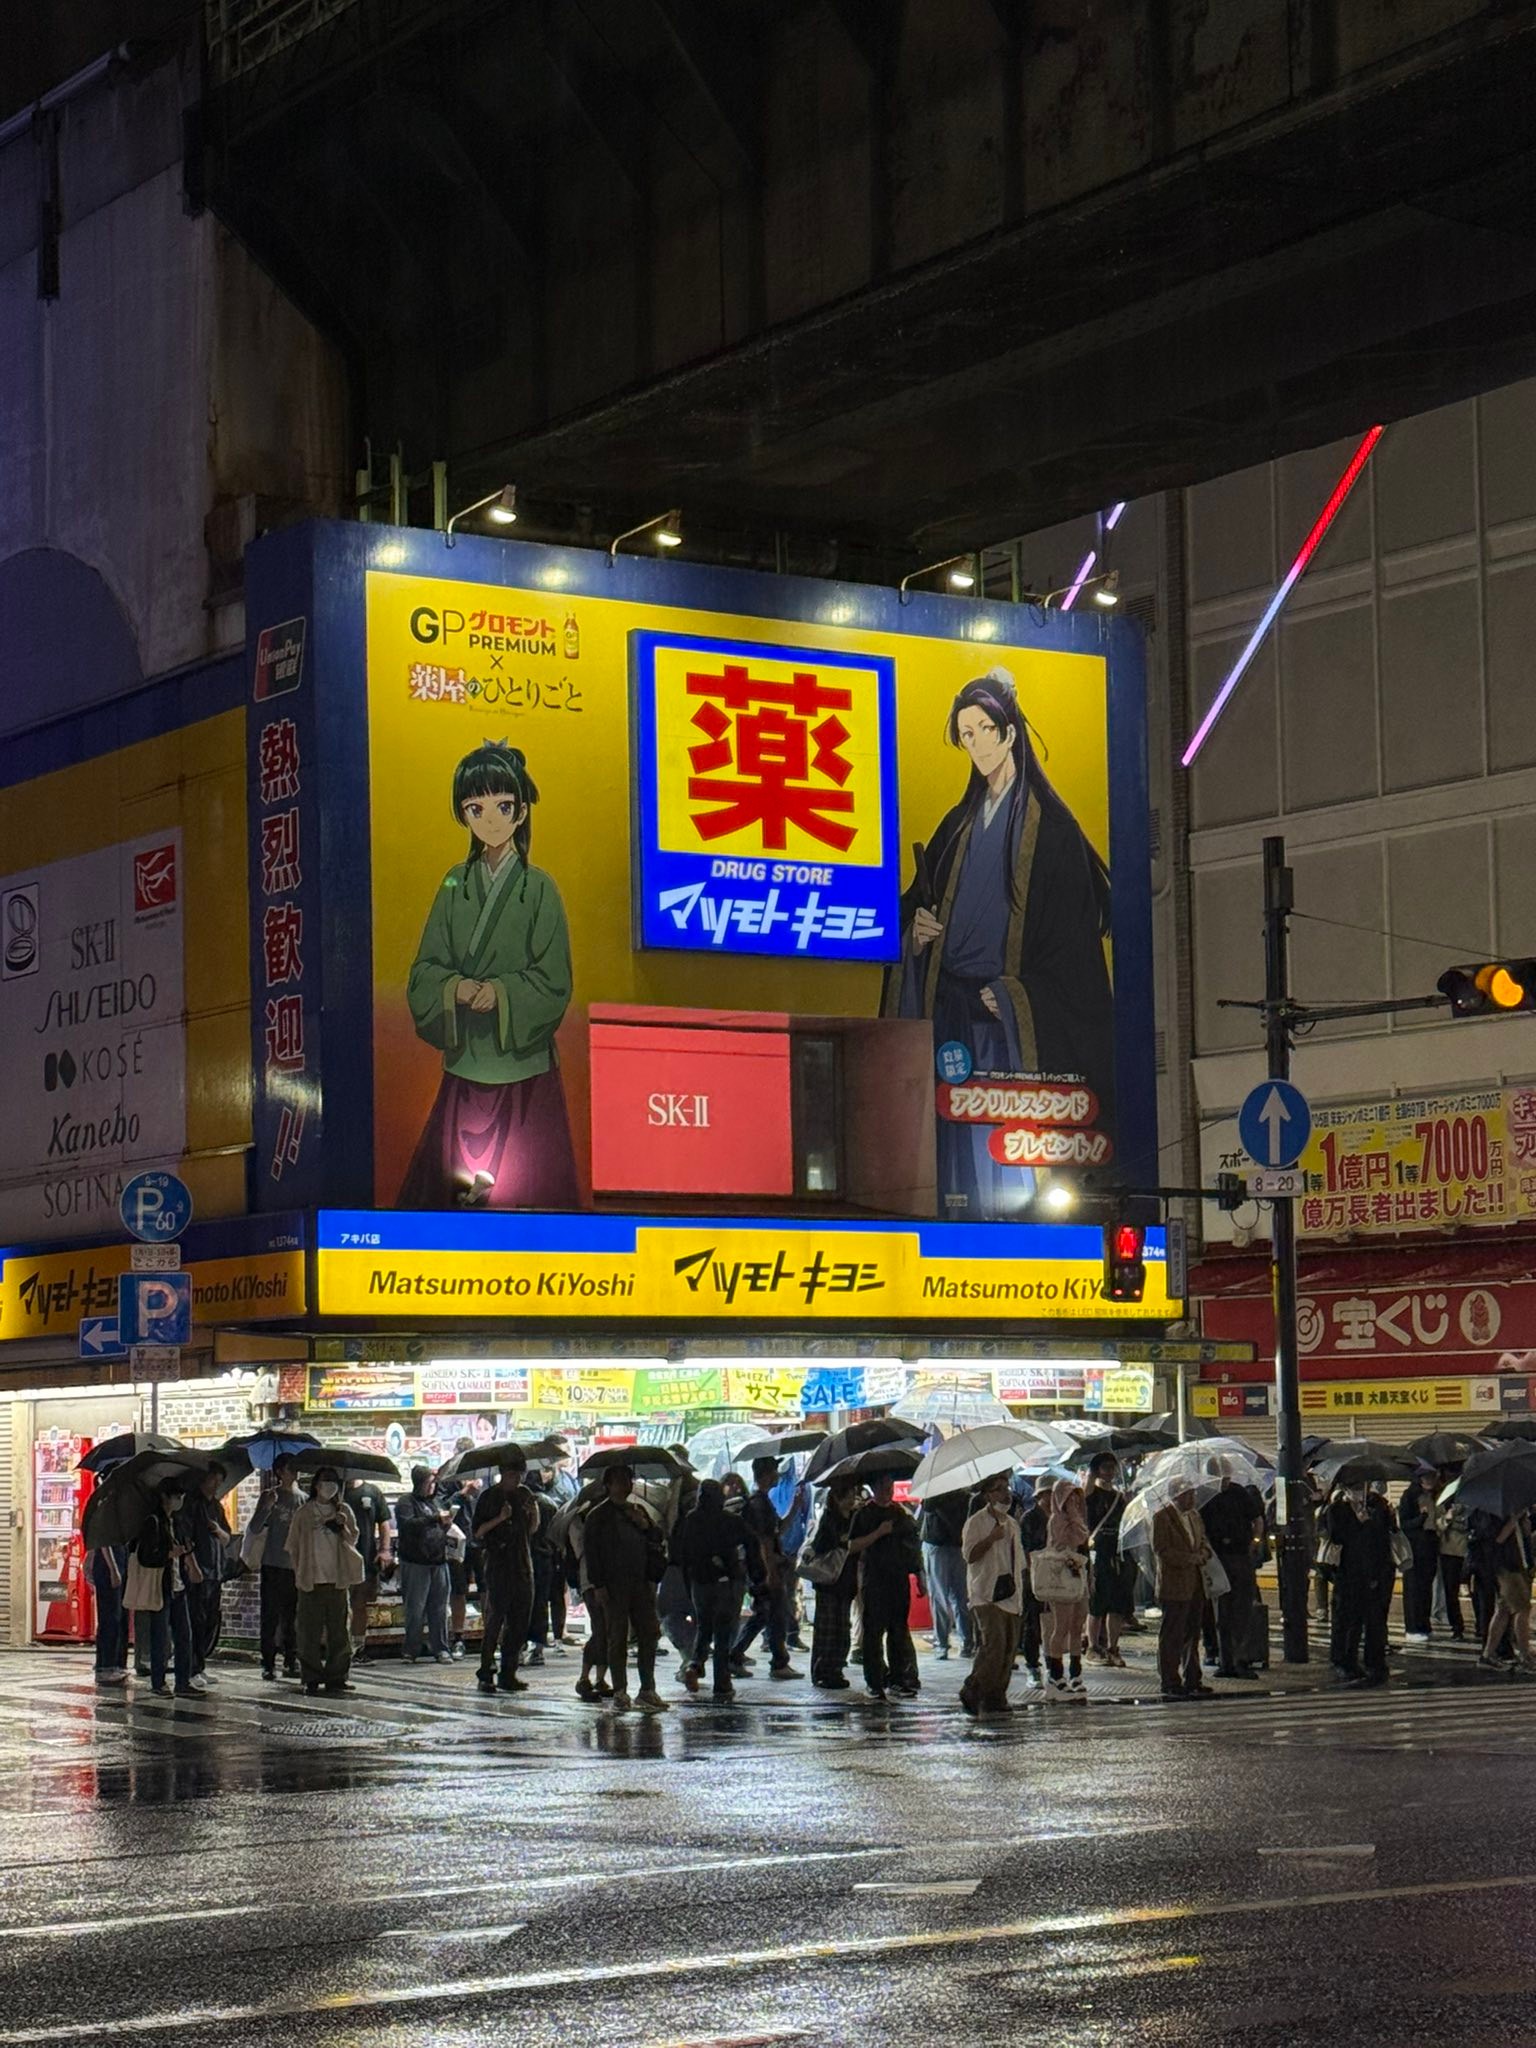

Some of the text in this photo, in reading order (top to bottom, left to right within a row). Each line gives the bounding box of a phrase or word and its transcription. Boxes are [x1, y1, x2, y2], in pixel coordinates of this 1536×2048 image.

[410, 606, 465, 645] GP
[469, 610, 556, 638] グロモント
[469, 634, 556, 656] PREMIUM
[409, 662, 583, 712] 薬屋のひとりごと
[686, 664, 858, 852] 薬
[711, 860, 833, 886] DRUG STORE
[659, 881, 885, 950] マツモトキヨシ
[71, 917, 115, 970] SK-II
[34, 973, 157, 1033] SHISEIDO
[82, 1031, 143, 1086] KOSÉ
[648, 1092, 710, 1128] SK-II
[951, 1086, 1089, 1121] アクリルスタンド
[47, 1103, 140, 1157] Kanebo
[1219, 1148, 1250, 1169] スポー
[1319, 1131, 1390, 1192] 1億円
[44, 1172, 123, 1218] SOFINA
[137, 1187, 176, 1231] P 60
[1302, 1182, 1505, 1231] 億万長者出ました!!
[340, 1233, 381, 1245] アキバ店
[231, 1272, 288, 1300] KiYoshi
[368, 1270, 636, 1297] Matsumoto KiYoshi
[674, 1246, 886, 1305] マツモトキヨシ
[922, 1276, 1058, 1299] Matsumoto
[139, 1281, 178, 1338] P
[1332, 1293, 1449, 1349] 宝くじ
[346, 1399, 371, 1408] TAX
